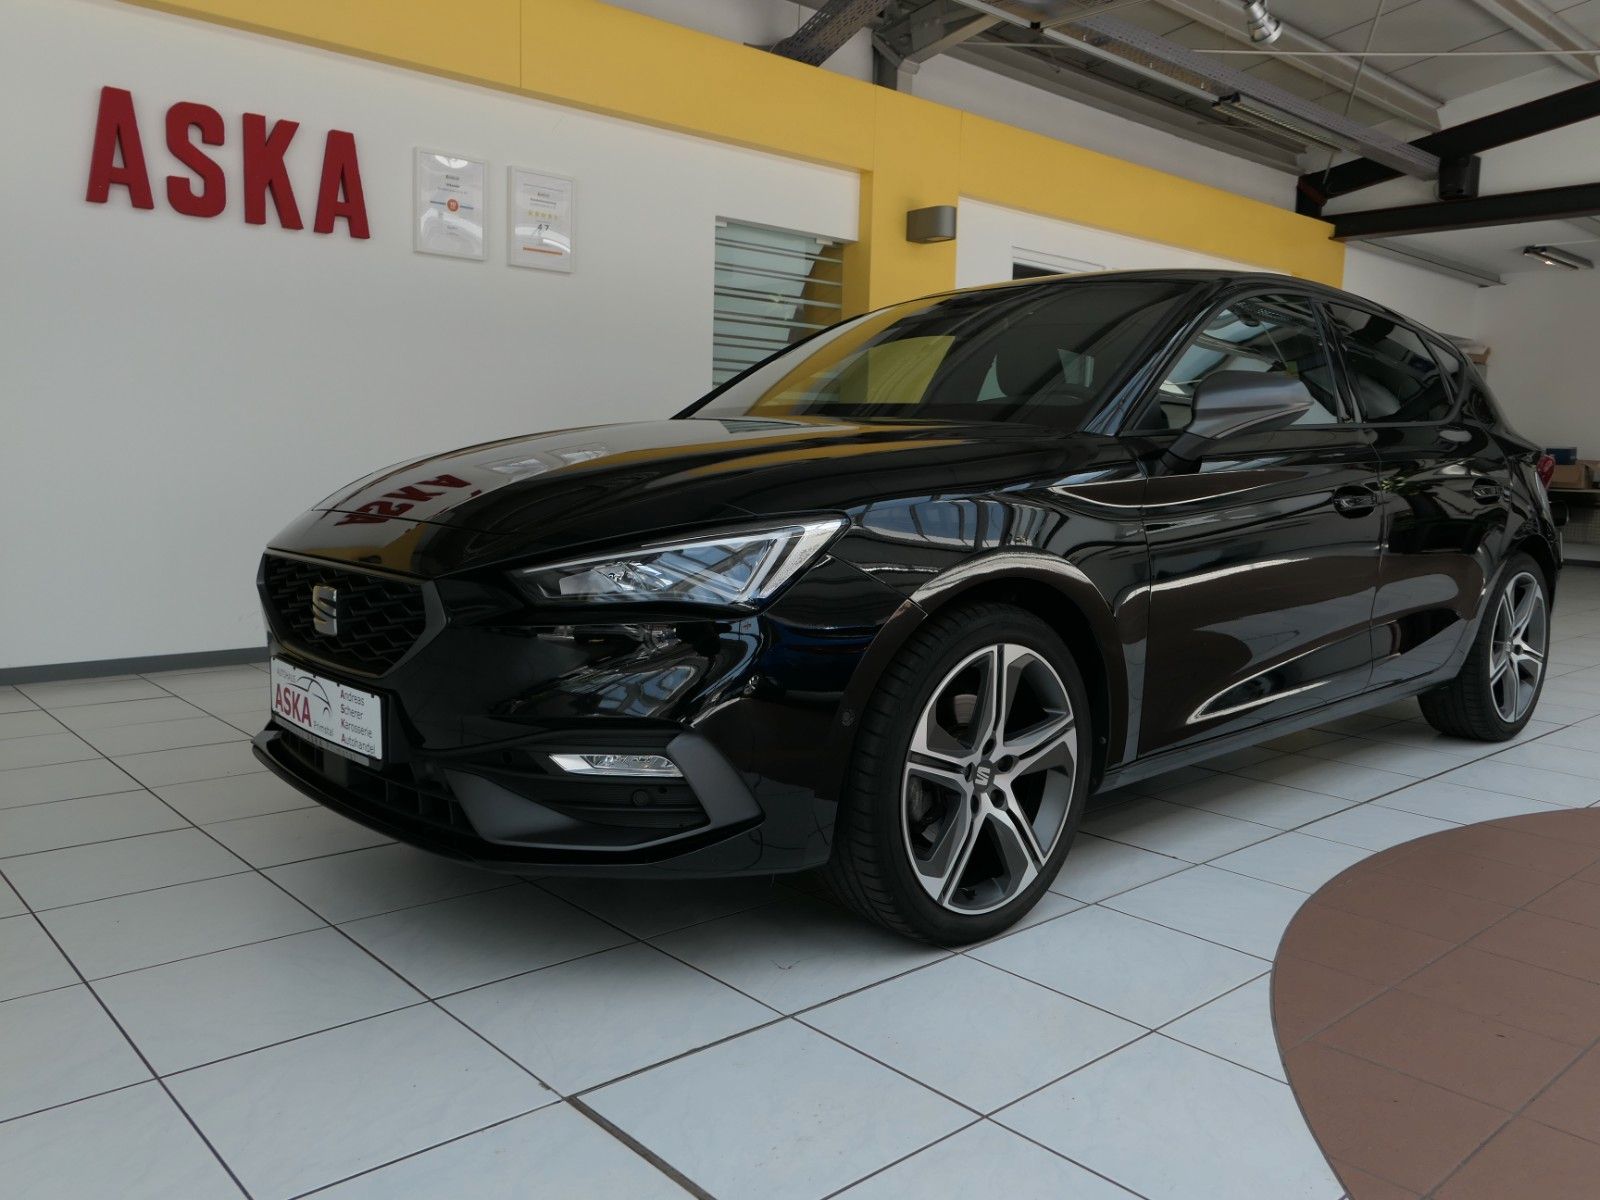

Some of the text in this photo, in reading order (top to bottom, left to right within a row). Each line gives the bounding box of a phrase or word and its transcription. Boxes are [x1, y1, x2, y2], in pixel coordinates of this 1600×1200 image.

[86, 86, 370, 239] ASKA
[275, 683, 312, 727] ASKA
[340, 689, 365, 706] Andreas
